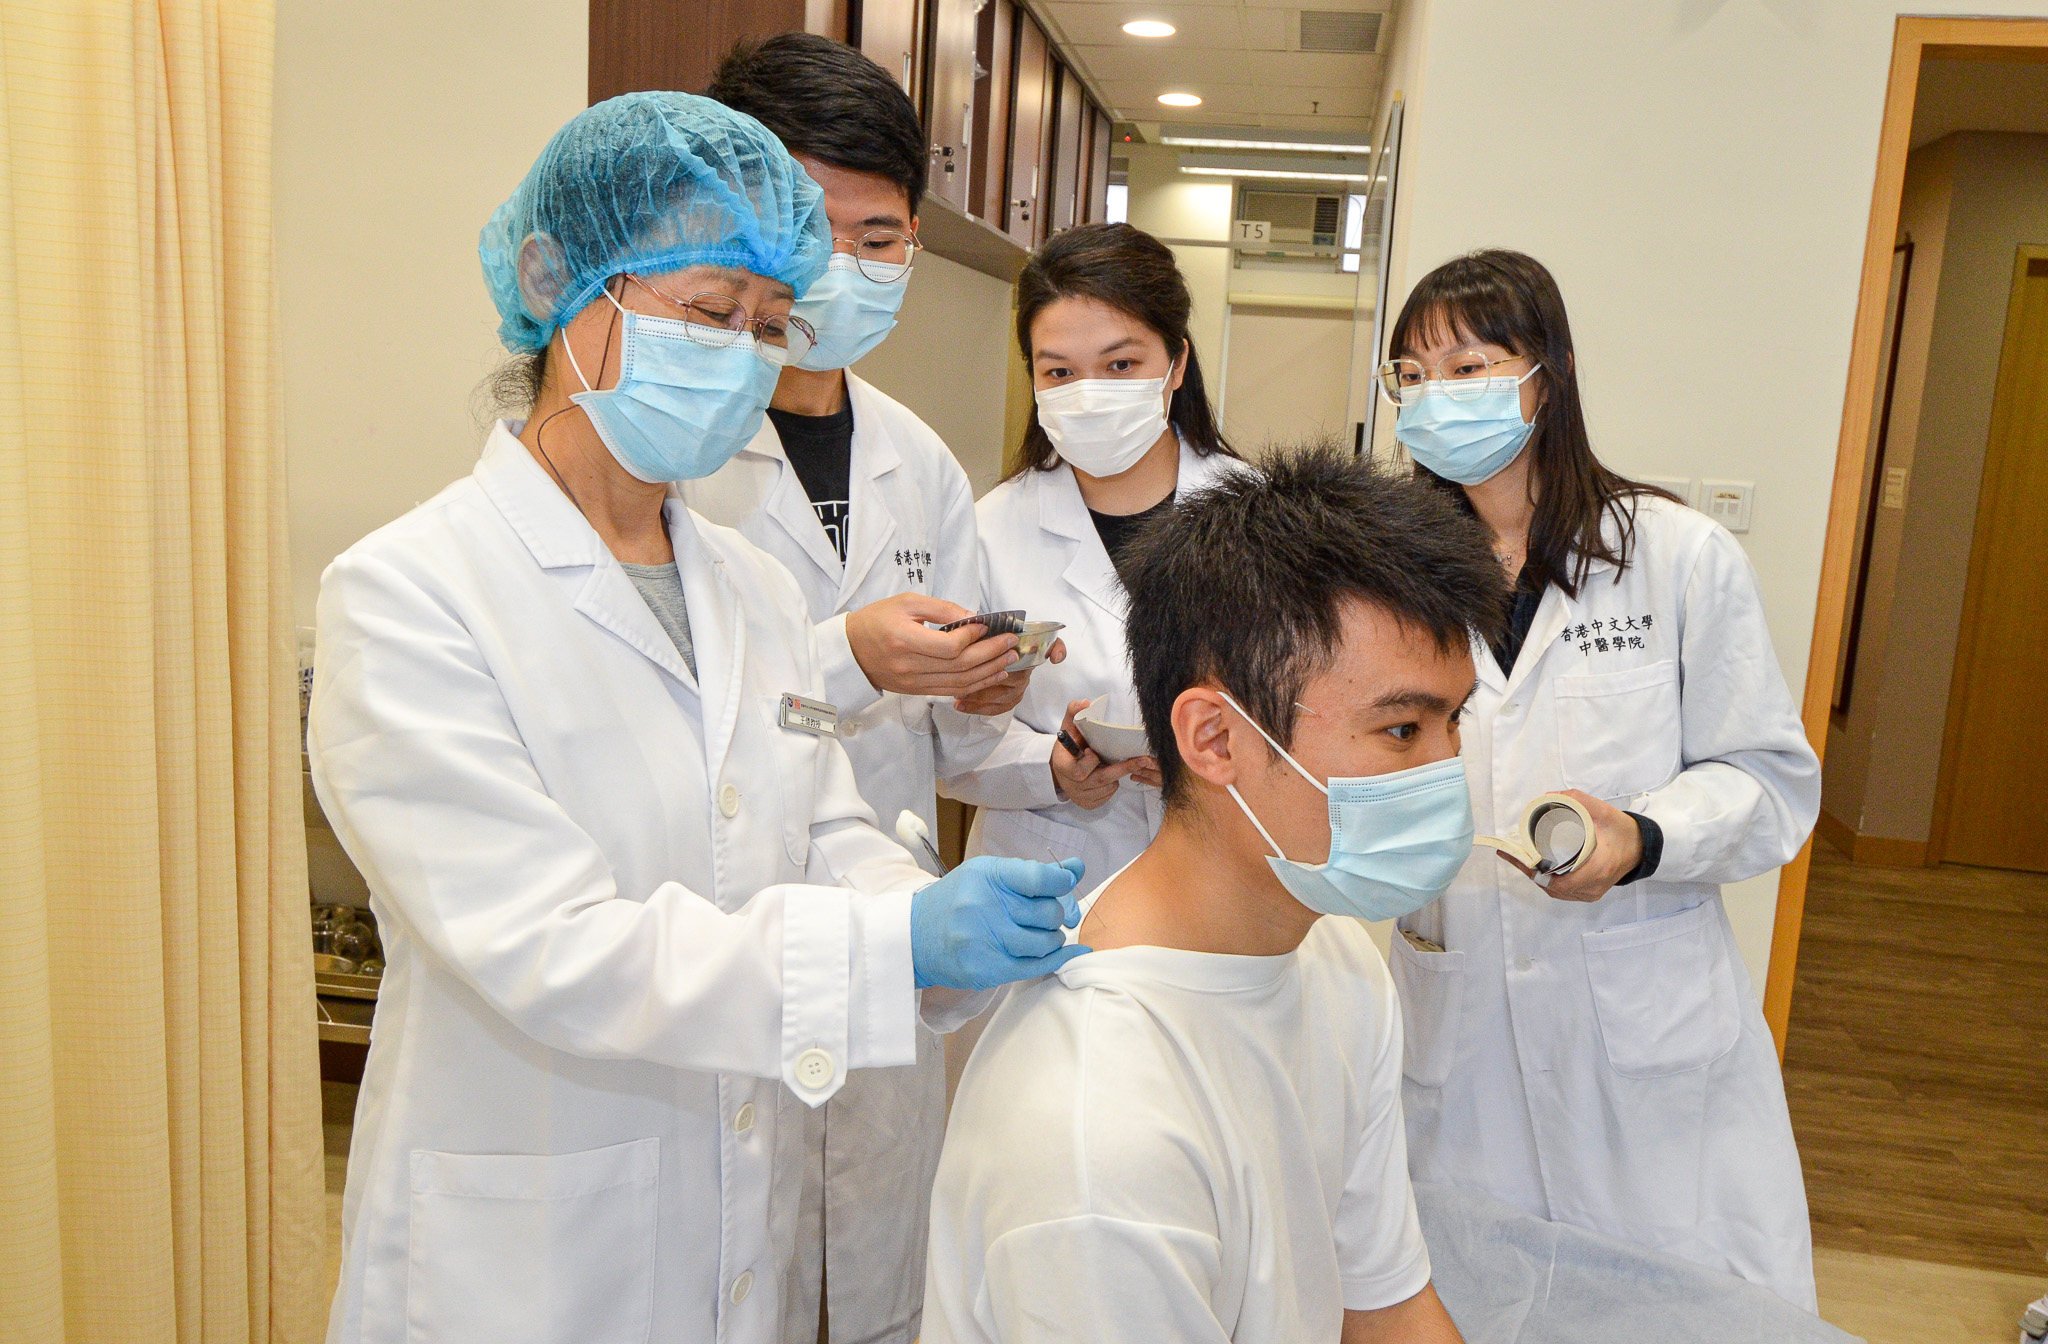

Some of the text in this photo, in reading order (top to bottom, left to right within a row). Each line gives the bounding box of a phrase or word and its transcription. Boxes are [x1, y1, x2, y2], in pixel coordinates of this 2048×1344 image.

[1561, 614, 1653, 642] 香港中文大學
[1579, 635, 1645, 656] 中醫學院
